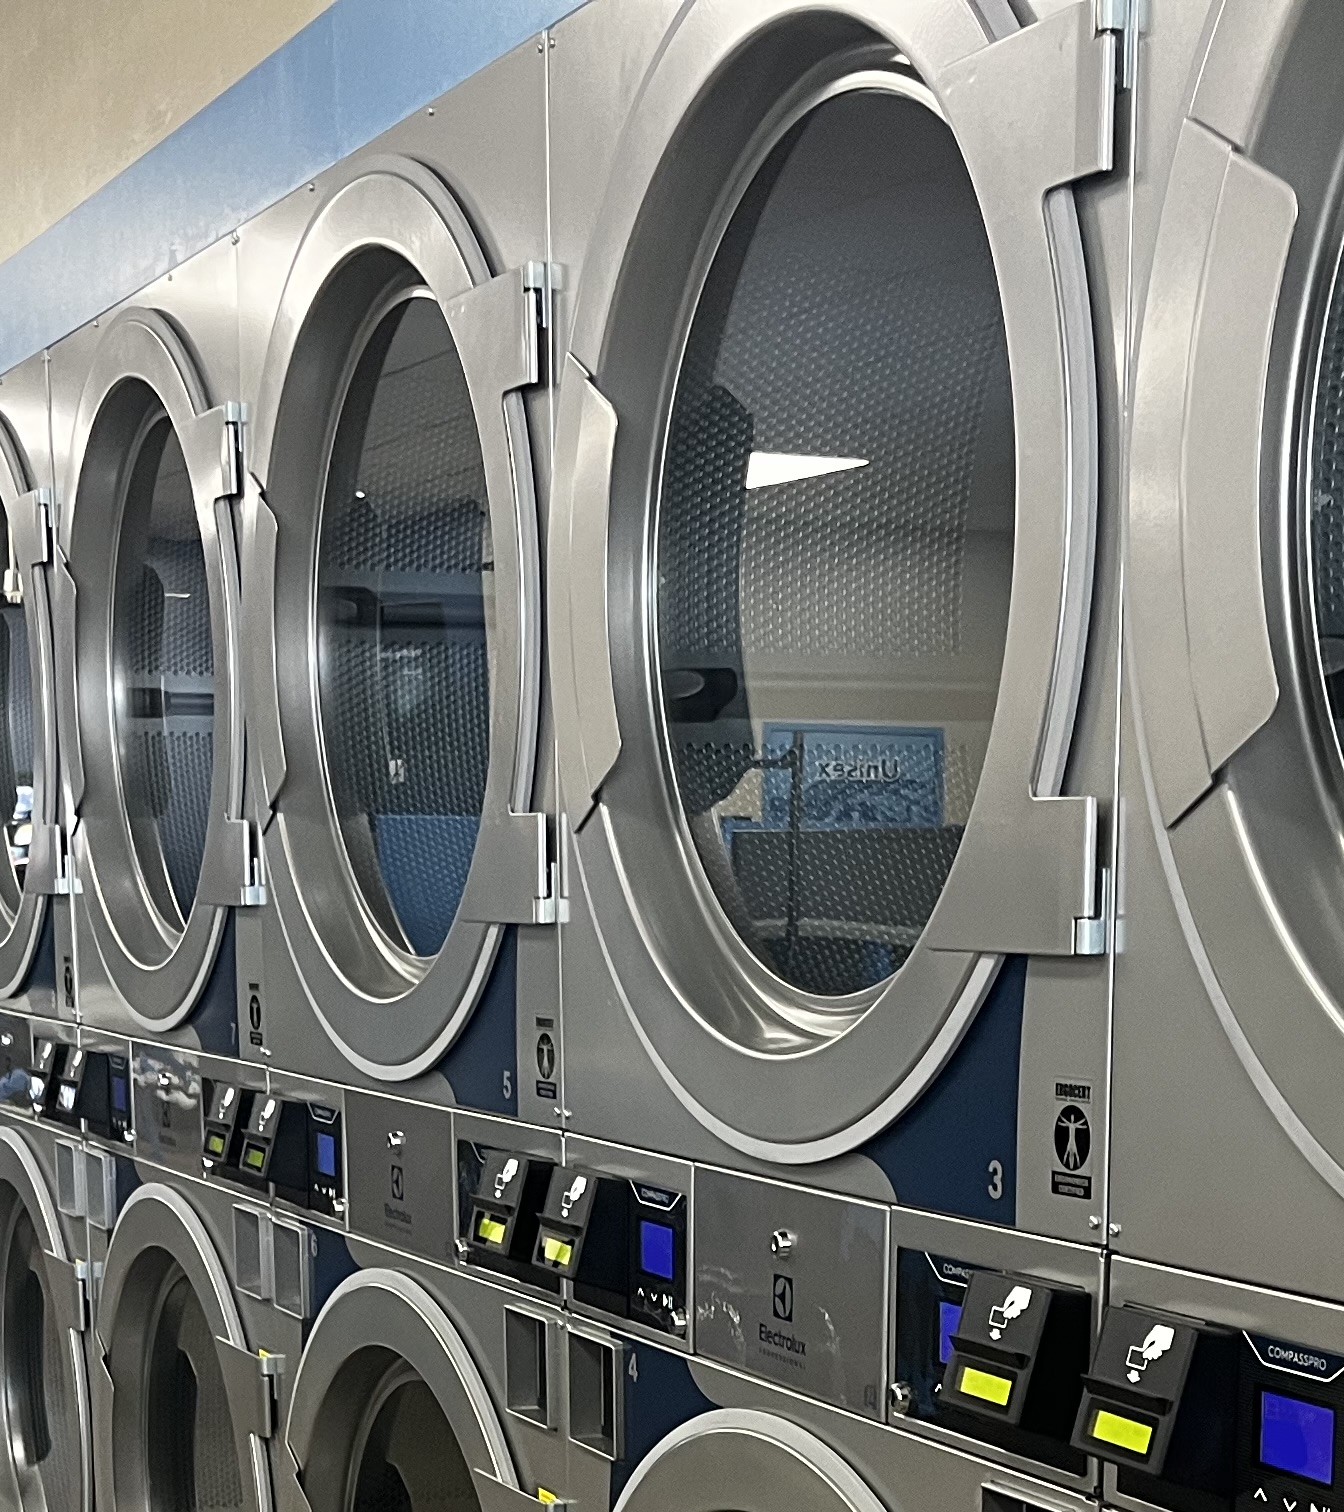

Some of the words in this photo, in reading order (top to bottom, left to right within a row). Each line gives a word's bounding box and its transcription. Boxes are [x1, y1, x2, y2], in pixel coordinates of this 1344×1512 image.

[502, 1069, 512, 1100] 5
[987, 1159, 1003, 1200] 3
[758, 1321, 807, 1357] Electrolux
[628, 1352, 639, 1383] 4
[1267, 1345, 1327, 1371] COMPASSPRO
